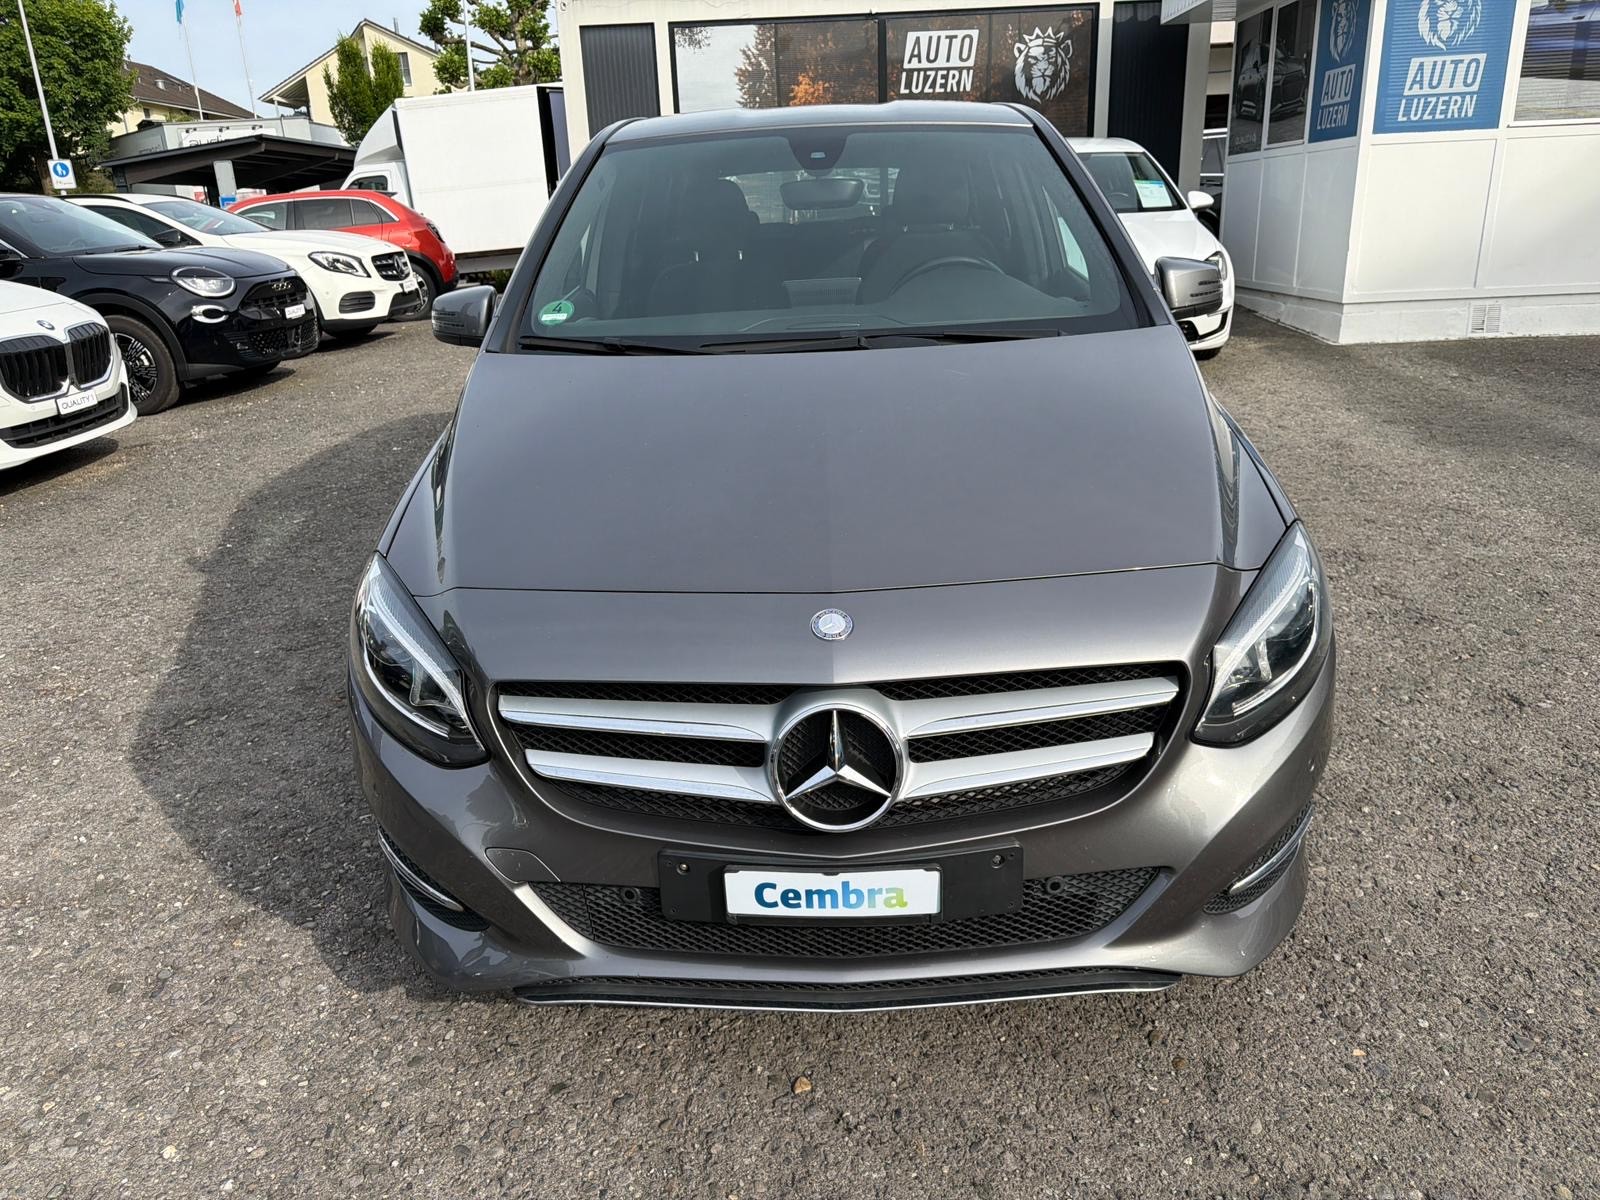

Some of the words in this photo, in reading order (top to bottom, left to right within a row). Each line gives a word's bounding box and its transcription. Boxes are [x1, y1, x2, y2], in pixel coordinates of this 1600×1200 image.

[907, 34, 974, 65] AUTO
[900, 69, 974, 94] LUZERN
[1323, 69, 1353, 101] AUTO
[1408, 58, 1480, 91] AUTO
[1317, 104, 1349, 130] LUZERN
[1398, 95, 1477, 121] LUZERN
[552, 302, 562, 313] 4
[62, 395, 90, 409] QUALITY
[754, 881, 908, 909] Cembra
